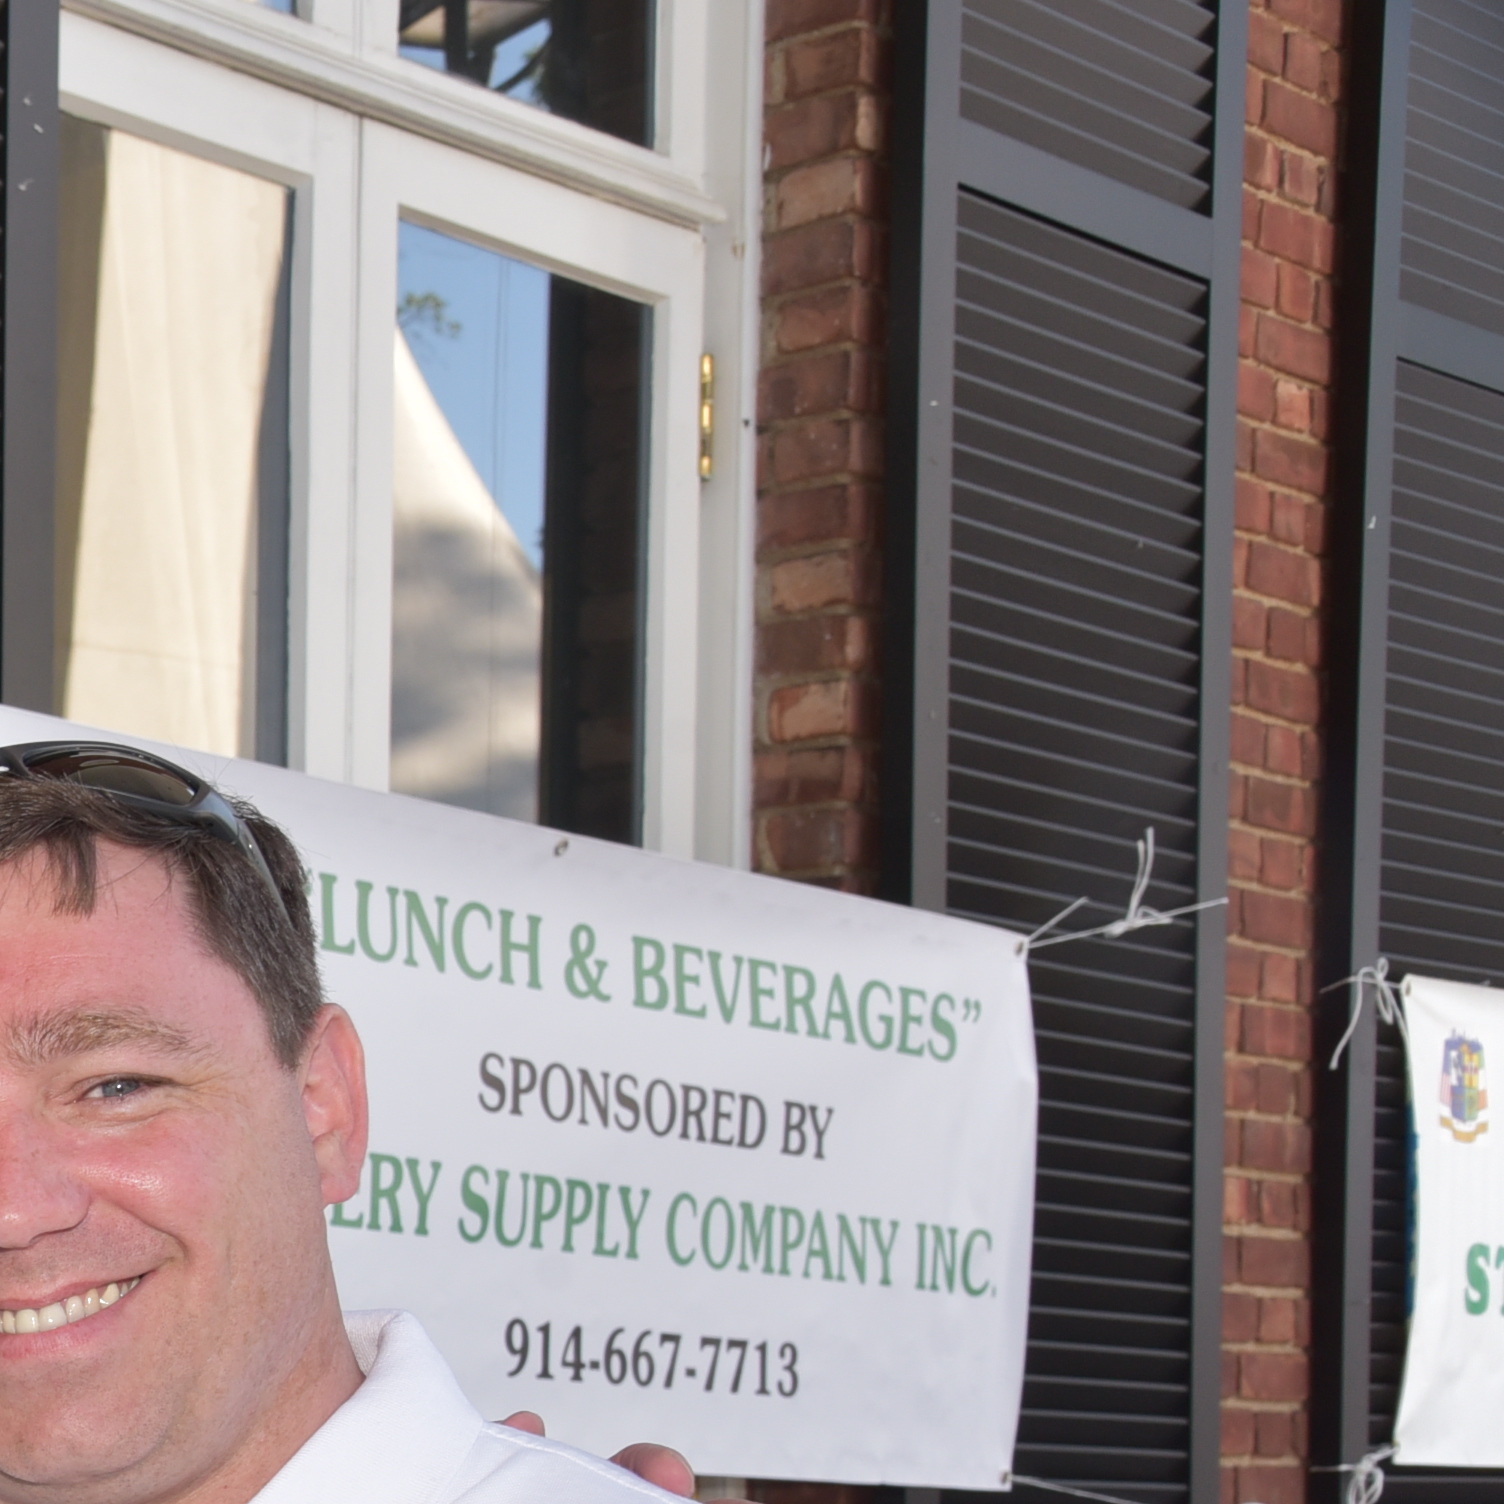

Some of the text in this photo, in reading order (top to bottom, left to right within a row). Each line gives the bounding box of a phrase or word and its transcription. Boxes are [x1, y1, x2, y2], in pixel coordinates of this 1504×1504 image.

[563, 922, 611, 1002] &
[631, 935, 982, 1062] BEVERAGES”
[478, 1052, 834, 1160] SPONSORED BY
[458, 1164, 651, 1260] SUPPLY
[665, 1192, 900, 1286] COMPANY
[914, 1222, 996, 1298] INC.
[504, 1317, 799, 1398] 914-667-7713
